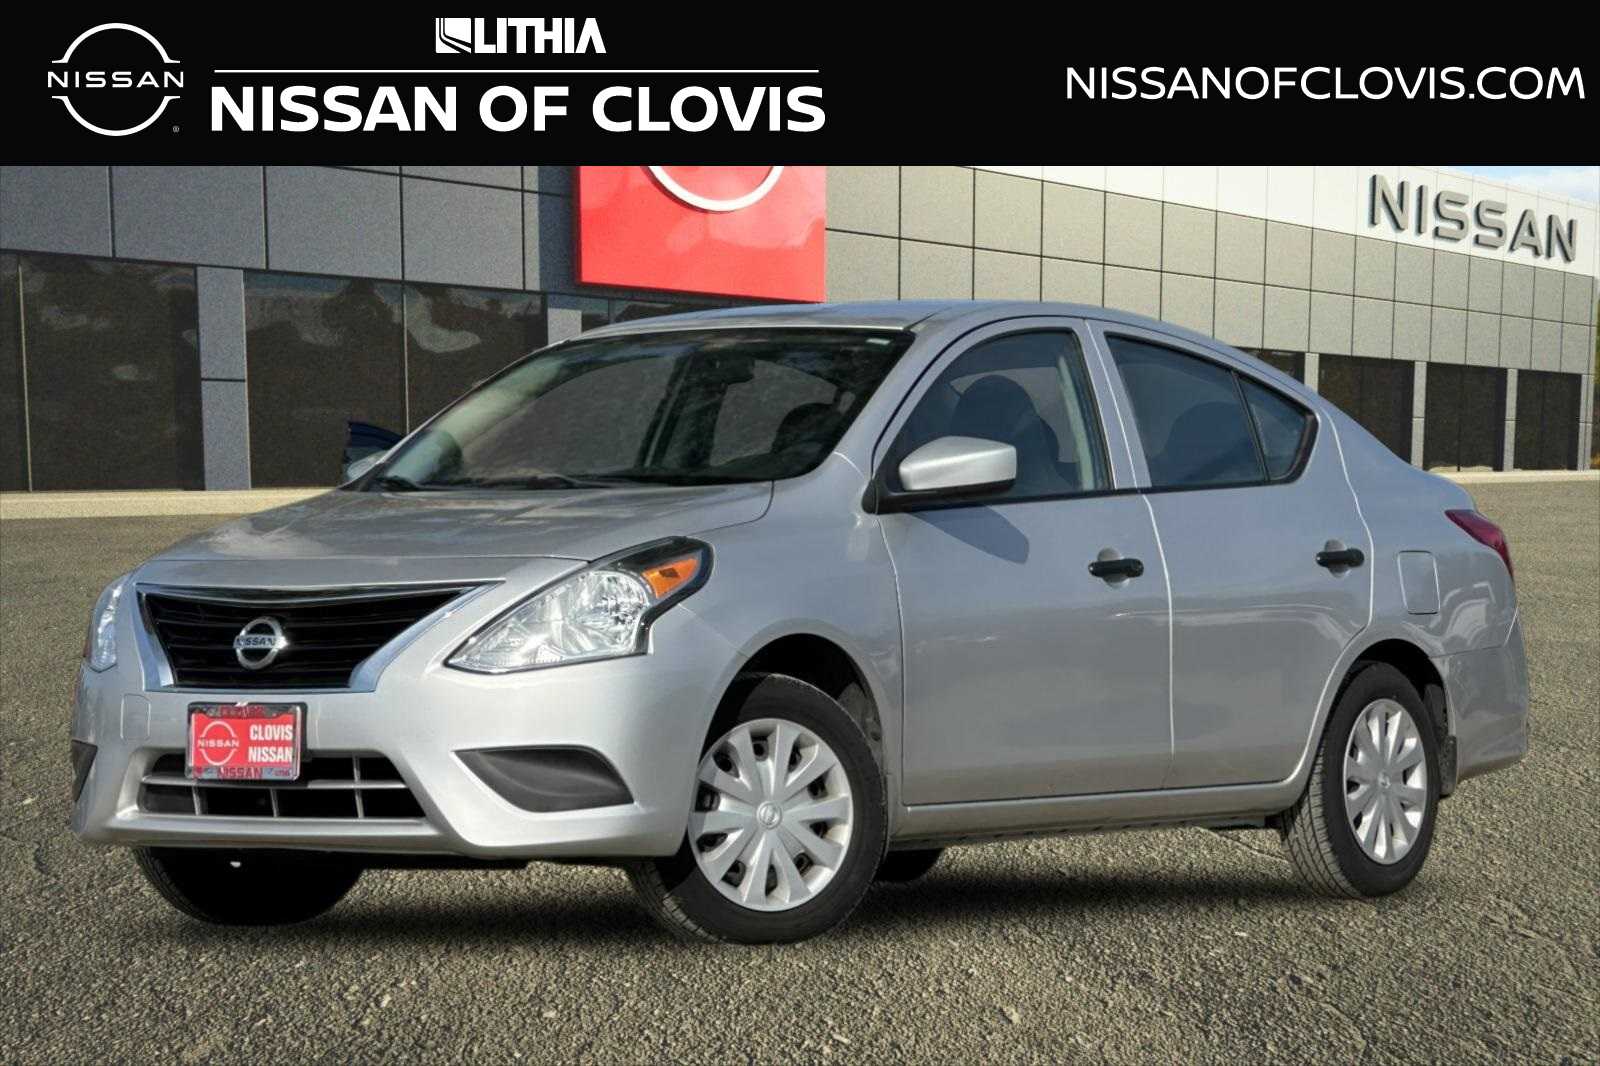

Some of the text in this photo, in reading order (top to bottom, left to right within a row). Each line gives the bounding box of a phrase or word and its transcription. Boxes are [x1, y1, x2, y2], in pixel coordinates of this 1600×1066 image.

[1369, 174, 1578, 263] NISSAN
[249, 724, 293, 741] CLOVIS
[197, 738, 240, 748] NISSAN
[247, 746, 293, 762] NISSAN
